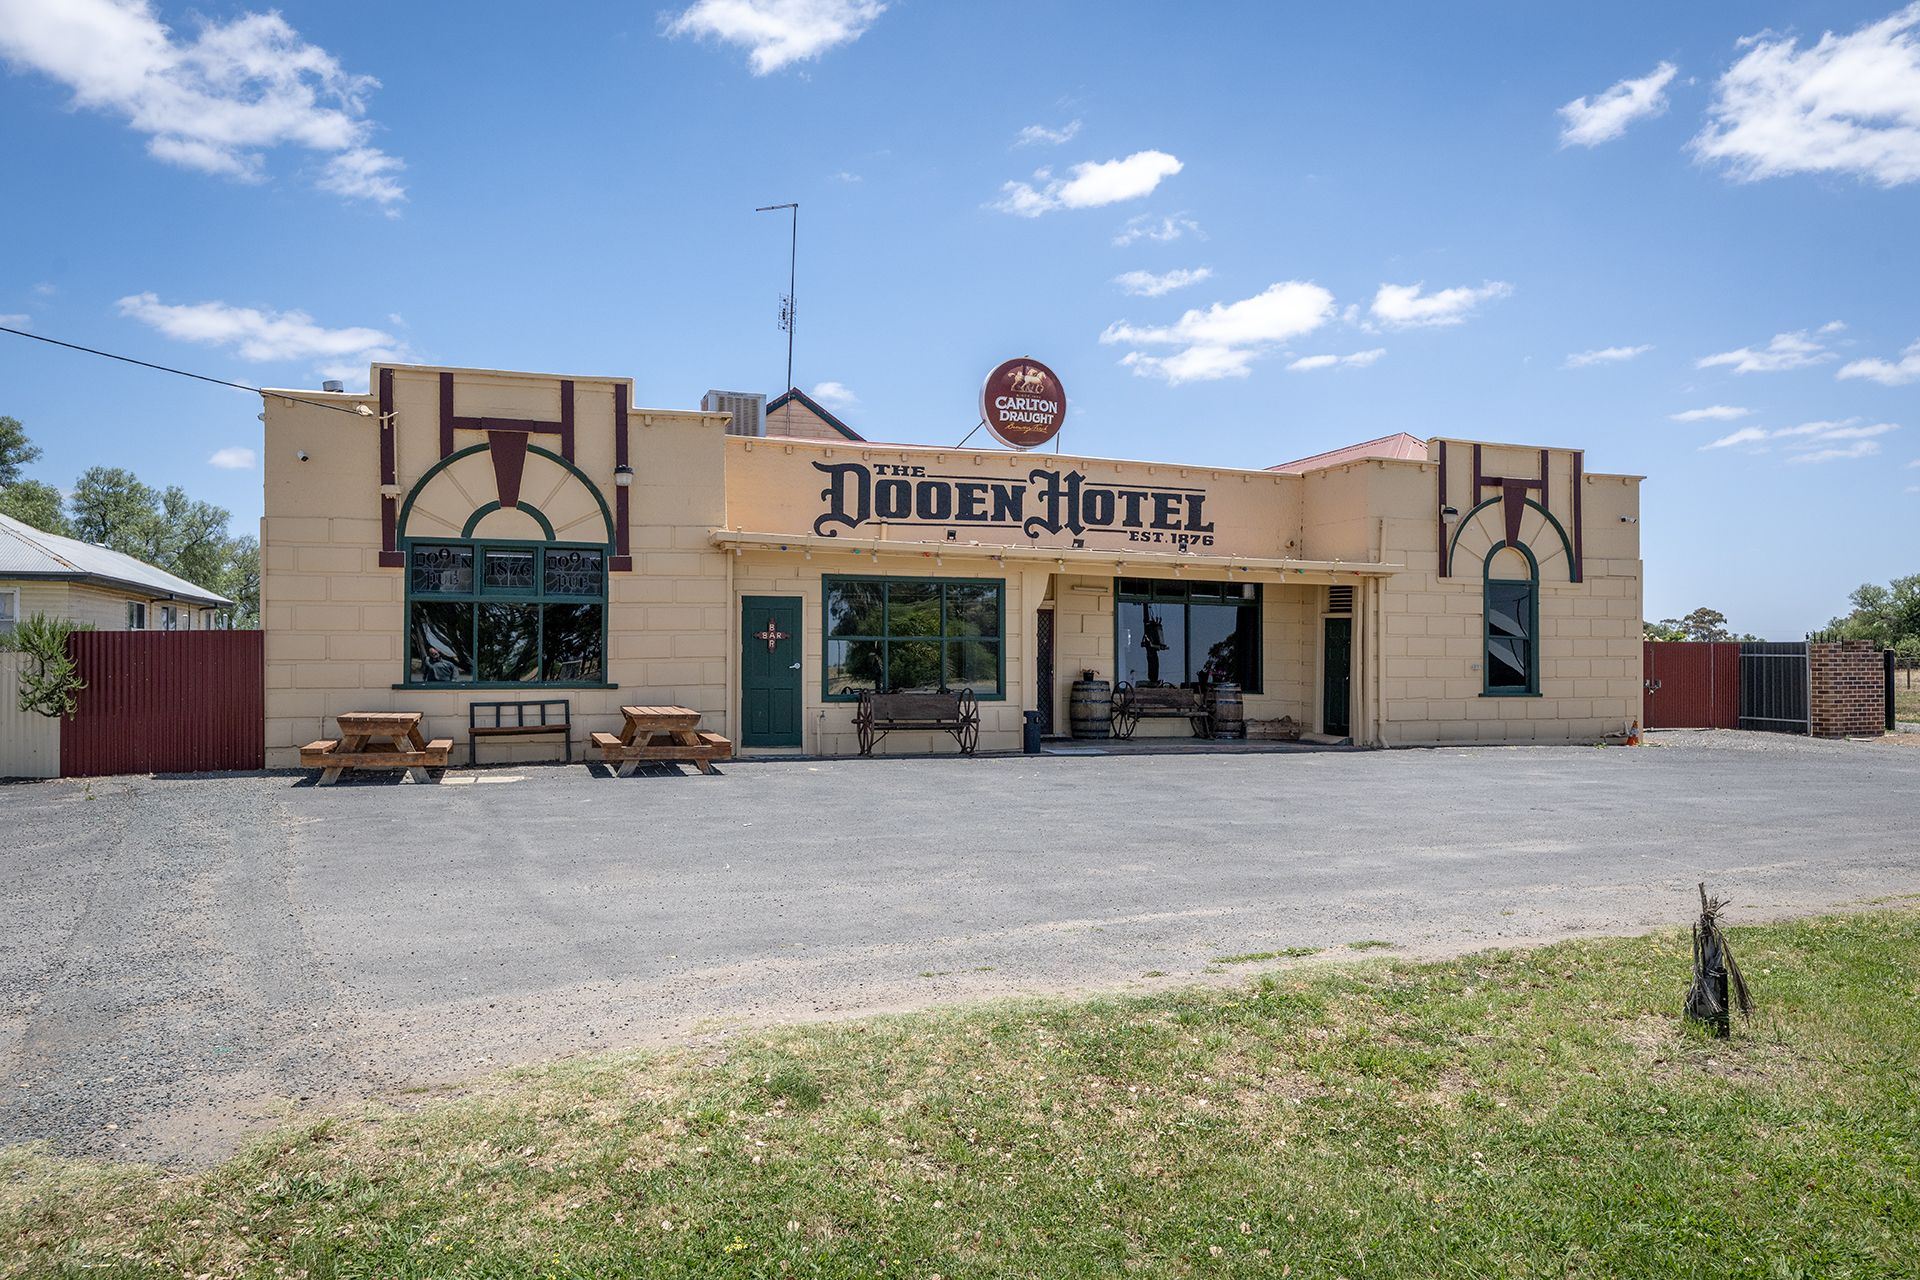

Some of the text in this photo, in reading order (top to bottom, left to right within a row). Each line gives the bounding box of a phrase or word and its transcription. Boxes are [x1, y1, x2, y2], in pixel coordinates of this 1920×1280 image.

[995, 396, 1058, 414] CARLTON
[999, 410, 1054, 425] DRAUGHT
[873, 463, 926, 478] THE
[811, 460, 1215, 540] DOOEN HOTEL
[768, 623, 776, 648] BAR
